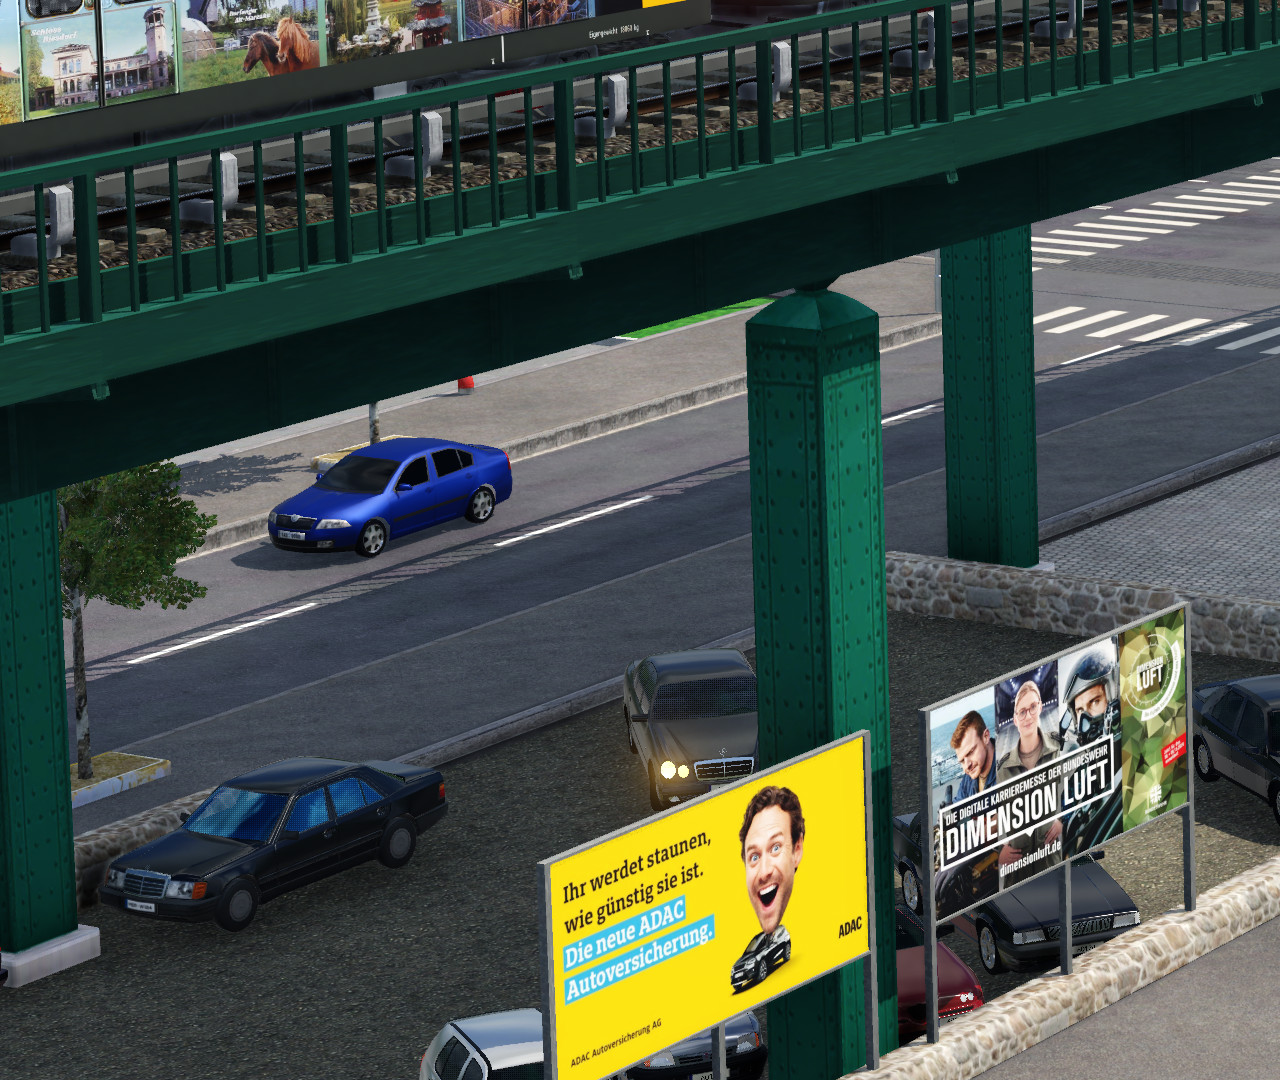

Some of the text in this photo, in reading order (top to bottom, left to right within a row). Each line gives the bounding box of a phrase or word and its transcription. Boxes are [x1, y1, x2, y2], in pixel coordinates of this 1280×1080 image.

[1136, 656, 1164, 673] DIMENSION
[1136, 665, 1163, 692] LUFT
[945, 745, 1108, 825] DIE DIGITALE KARRIEREMESSE DER BUNDESWEHR
[946, 758, 1109, 860] DIMENSION LUFT
[563, 831, 711, 903] Ihr werdet staunen,
[999, 839, 1062, 878] dimensionluft.de
[564, 862, 704, 934] wie günstig sie ist.
[838, 916, 863, 939] ADAC
[565, 900, 684, 969] Die neue ADAC
[566, 922, 713, 1001] Autoversicherung.
[570, 1018, 662, 1068] ADAC Autoversicherung AG
